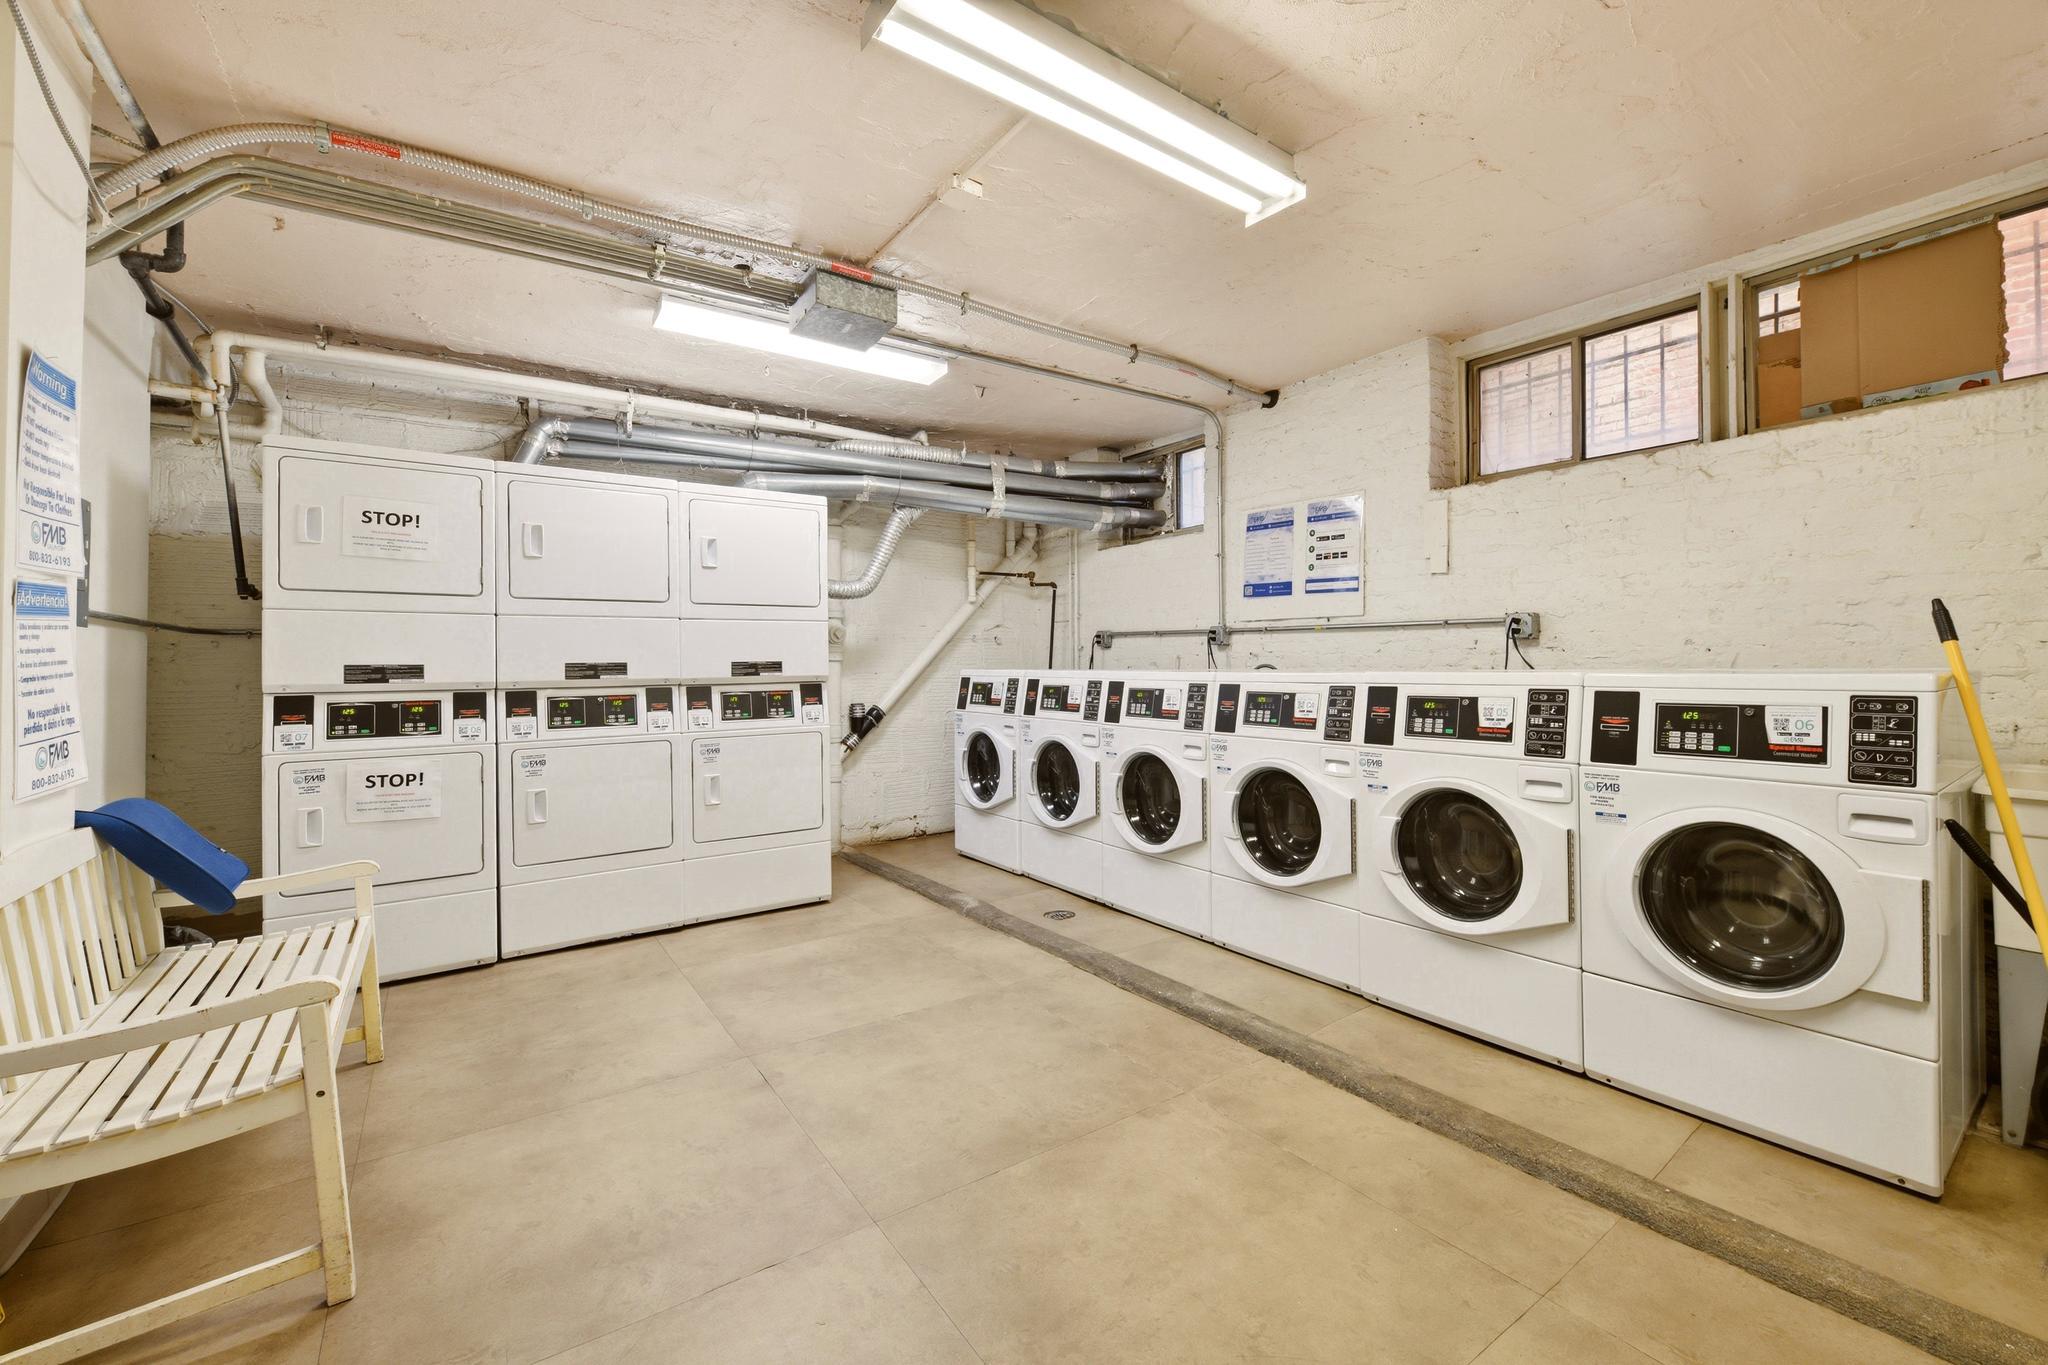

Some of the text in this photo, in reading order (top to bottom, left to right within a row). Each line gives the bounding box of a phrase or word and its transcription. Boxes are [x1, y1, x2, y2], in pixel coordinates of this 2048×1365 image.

[361, 510, 420, 528] STOP!
[42, 522, 66, 547] FMB
[29, 550, 71, 567] 800-832-6193
[1795, 719, 1815, 731] 06
[294, 733, 308, 742] 07
[49, 740, 69, 768] FMB
[529, 759, 546, 768] FMB
[1366, 759, 1383, 768] FMB
[32, 768, 75, 790] 800-832-6193
[304, 774, 326, 784] FMB
[365, 772, 424, 789] STOP!
[1596, 781, 1620, 794] FMB
